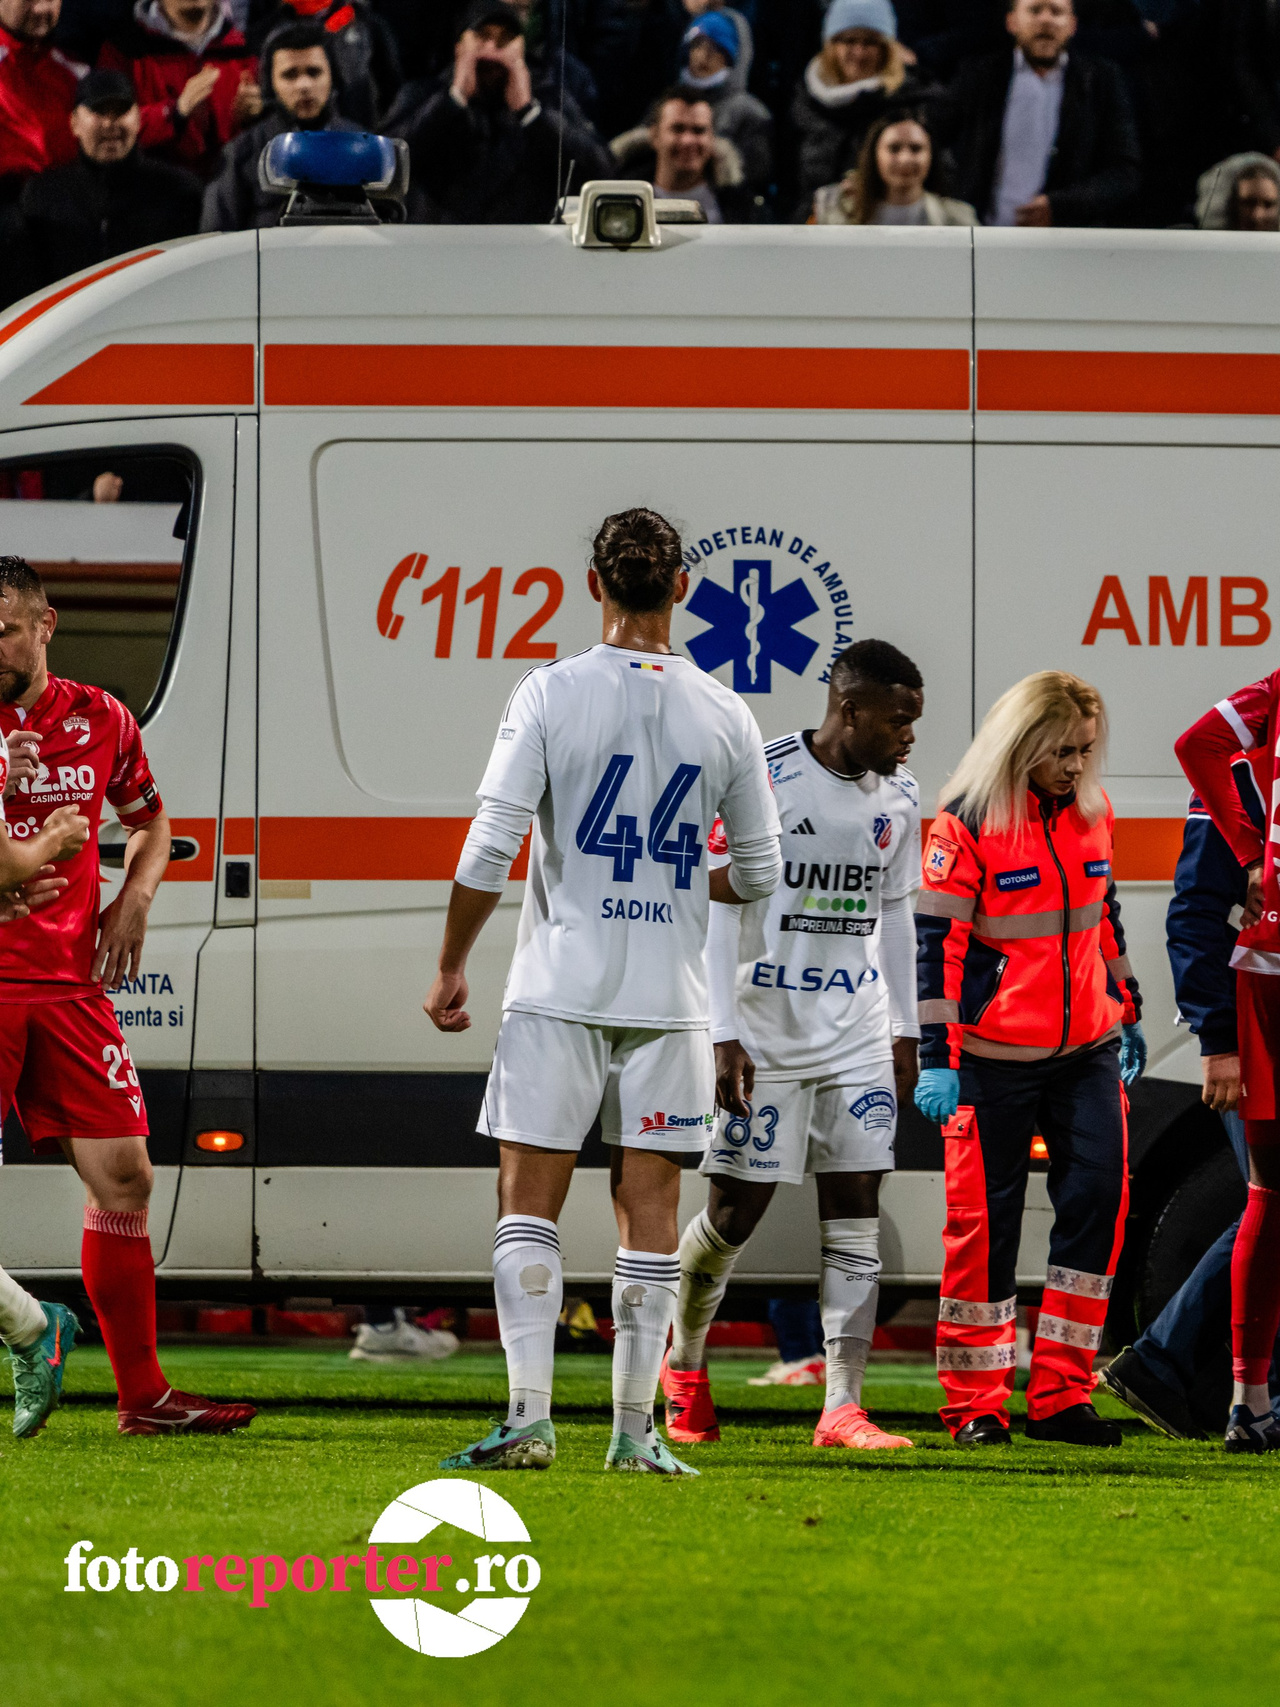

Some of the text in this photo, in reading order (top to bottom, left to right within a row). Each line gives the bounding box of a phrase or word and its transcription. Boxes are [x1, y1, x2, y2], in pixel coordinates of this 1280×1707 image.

[788, 536, 818, 564] DE
[421, 566, 564, 659] 112
[30, 794, 63, 804] CASINO
[576, 754, 703, 890] 44
[1000, 872, 1038, 886] BOTOSANI
[168, 1005, 184, 1027] si
[102, 1042, 141, 1089] 23
[667, 1114, 703, 1127] Smart
[724, 1100, 779, 1152] 83
[749, 1157, 780, 1169] Vestra
